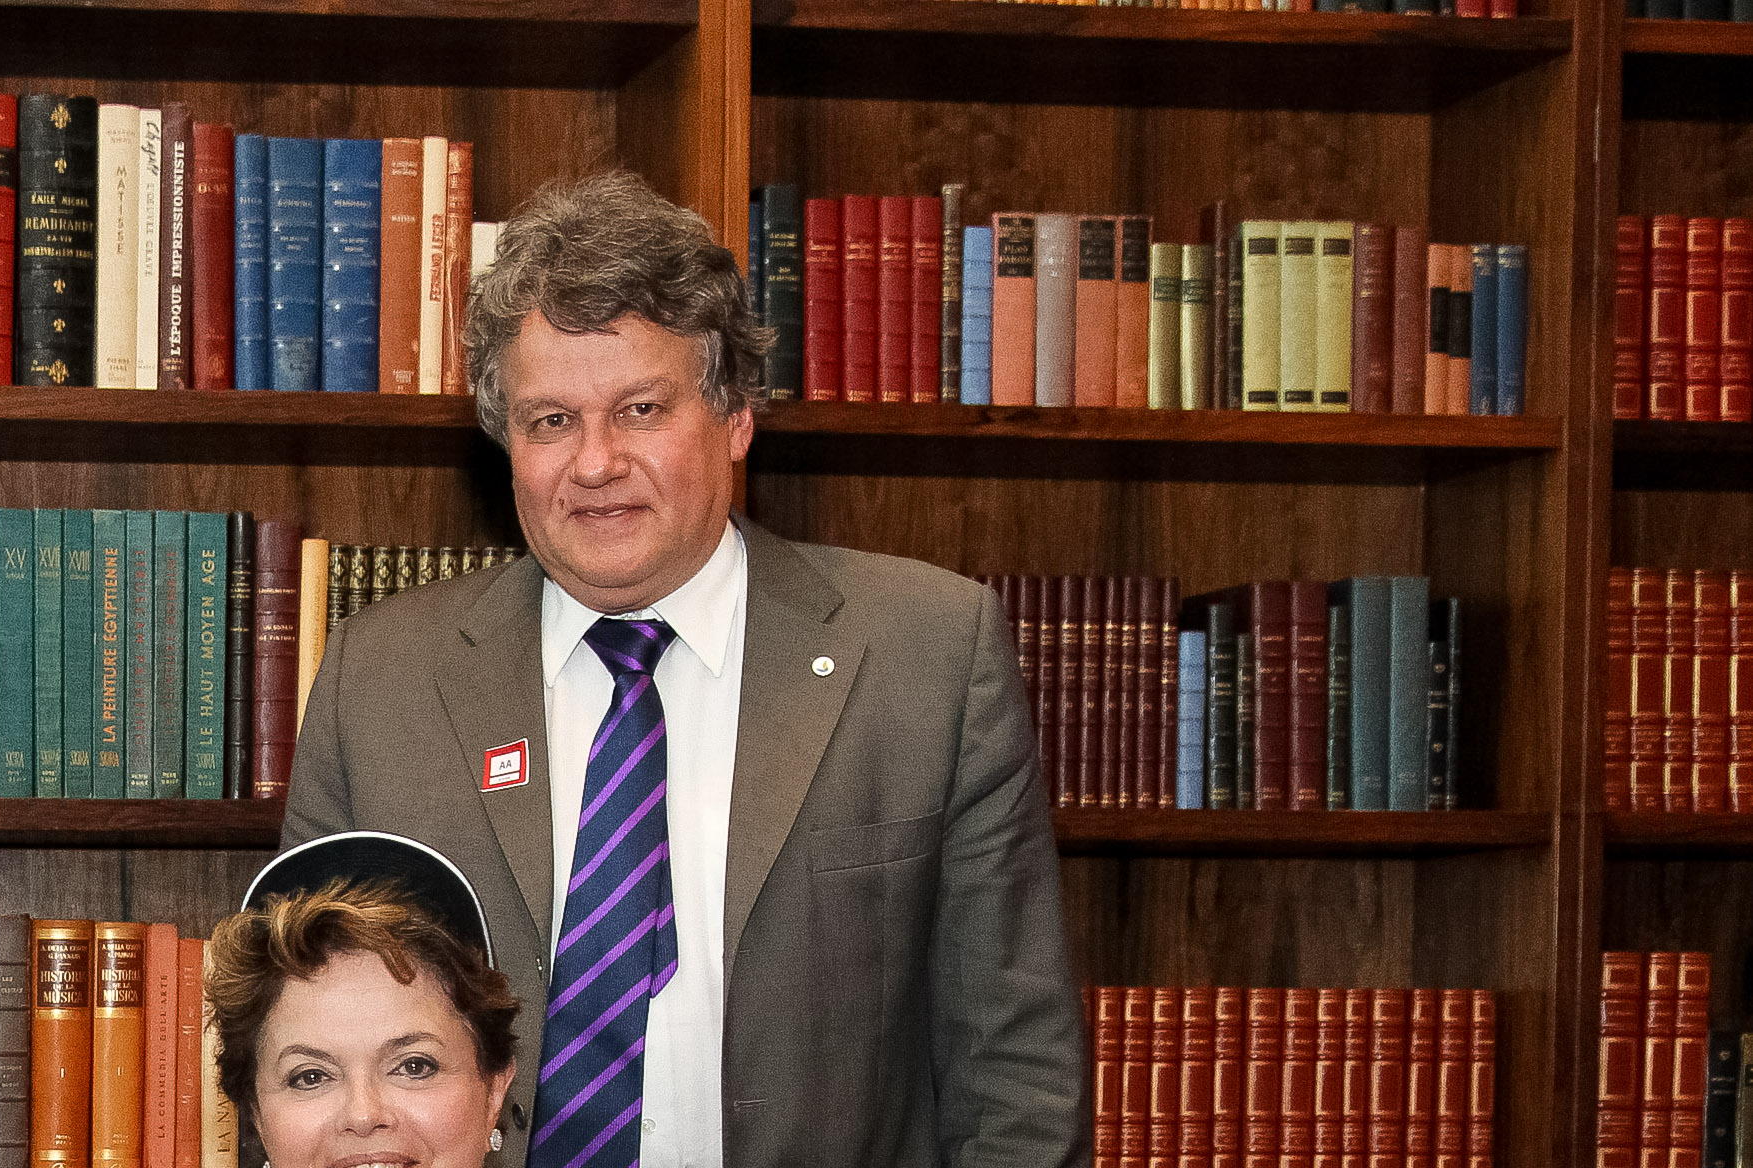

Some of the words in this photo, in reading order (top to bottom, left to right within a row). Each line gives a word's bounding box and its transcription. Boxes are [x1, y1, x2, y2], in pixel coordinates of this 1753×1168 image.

[116, 166, 127, 255] MATISSE
[171, 141, 185, 278] IMPRESSIONNISTE
[169, 284, 182, 356] L'ÉPOQUE
[5, 547, 26, 569] XV
[202, 549, 216, 585] AGE
[201, 596, 214, 659] MOYEN
[103, 649, 117, 720] PEINTURE
[201, 669, 214, 716] HAUT
[103, 726, 116, 742] LA
[200, 728, 213, 745] LE
[499, 759, 512, 770] AA
[159, 975, 167, 1041] DELL'ARTE
[158, 1050, 167, 1116] COMMEDIA
[158, 1125, 165, 1138] LA
[217, 1131, 230, 1153] LA
